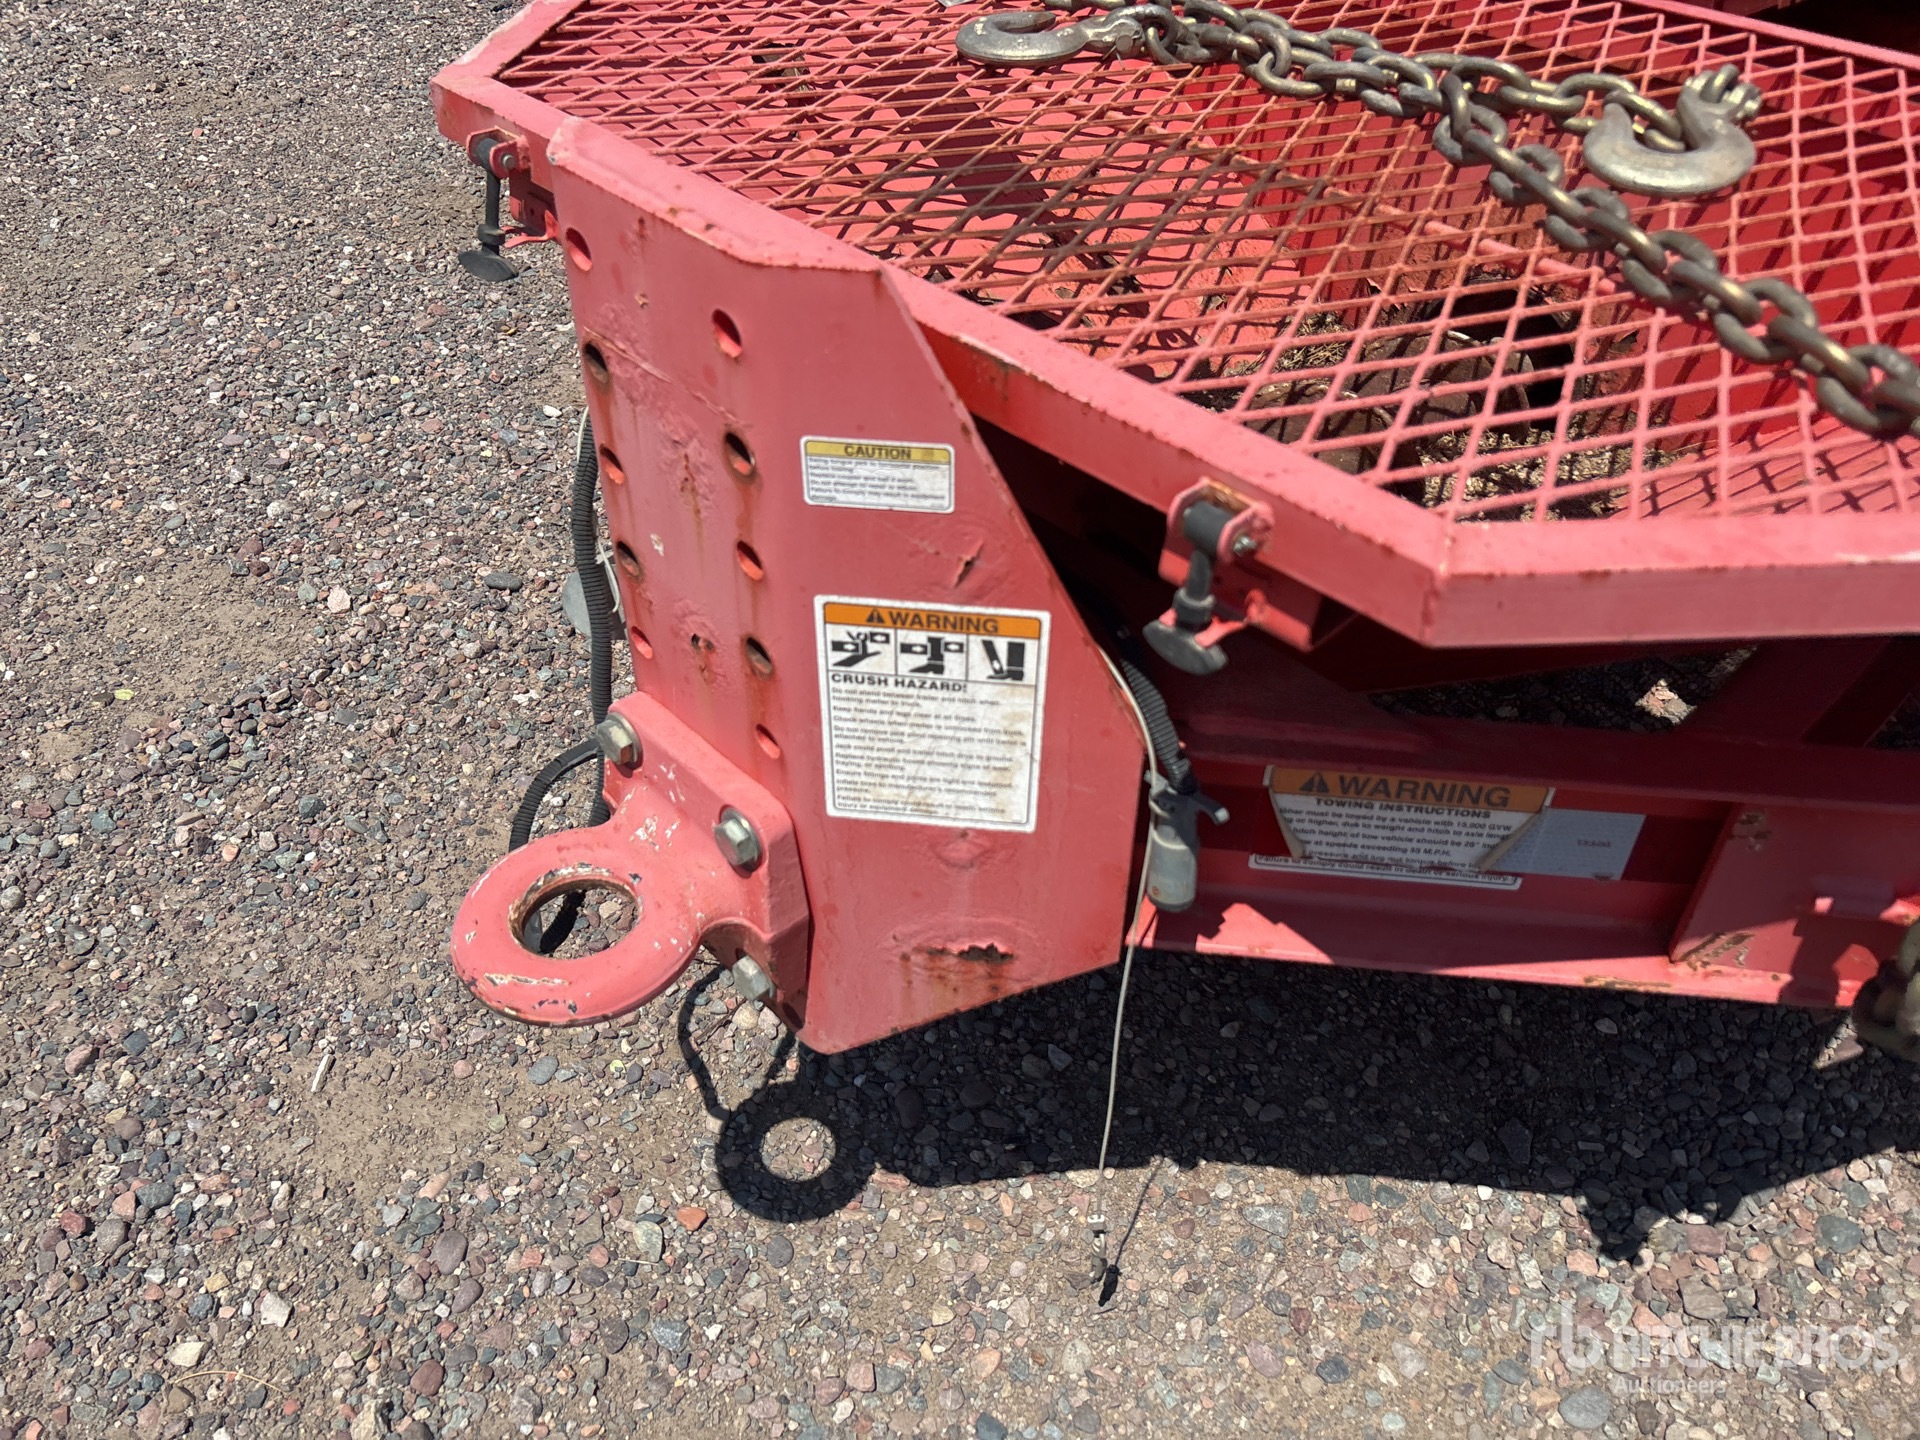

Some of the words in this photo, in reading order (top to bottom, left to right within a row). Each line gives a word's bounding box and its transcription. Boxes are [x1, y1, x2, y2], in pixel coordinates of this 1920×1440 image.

[844, 445, 911, 460] CAUTION
[889, 611, 999, 633] WARNING
[831, 673, 888, 686] CRUSH
[1337, 775, 1513, 808] WARNING
[1315, 798, 1375, 810] TOWING
[1378, 803, 1492, 820] INSTRUCTIONS
